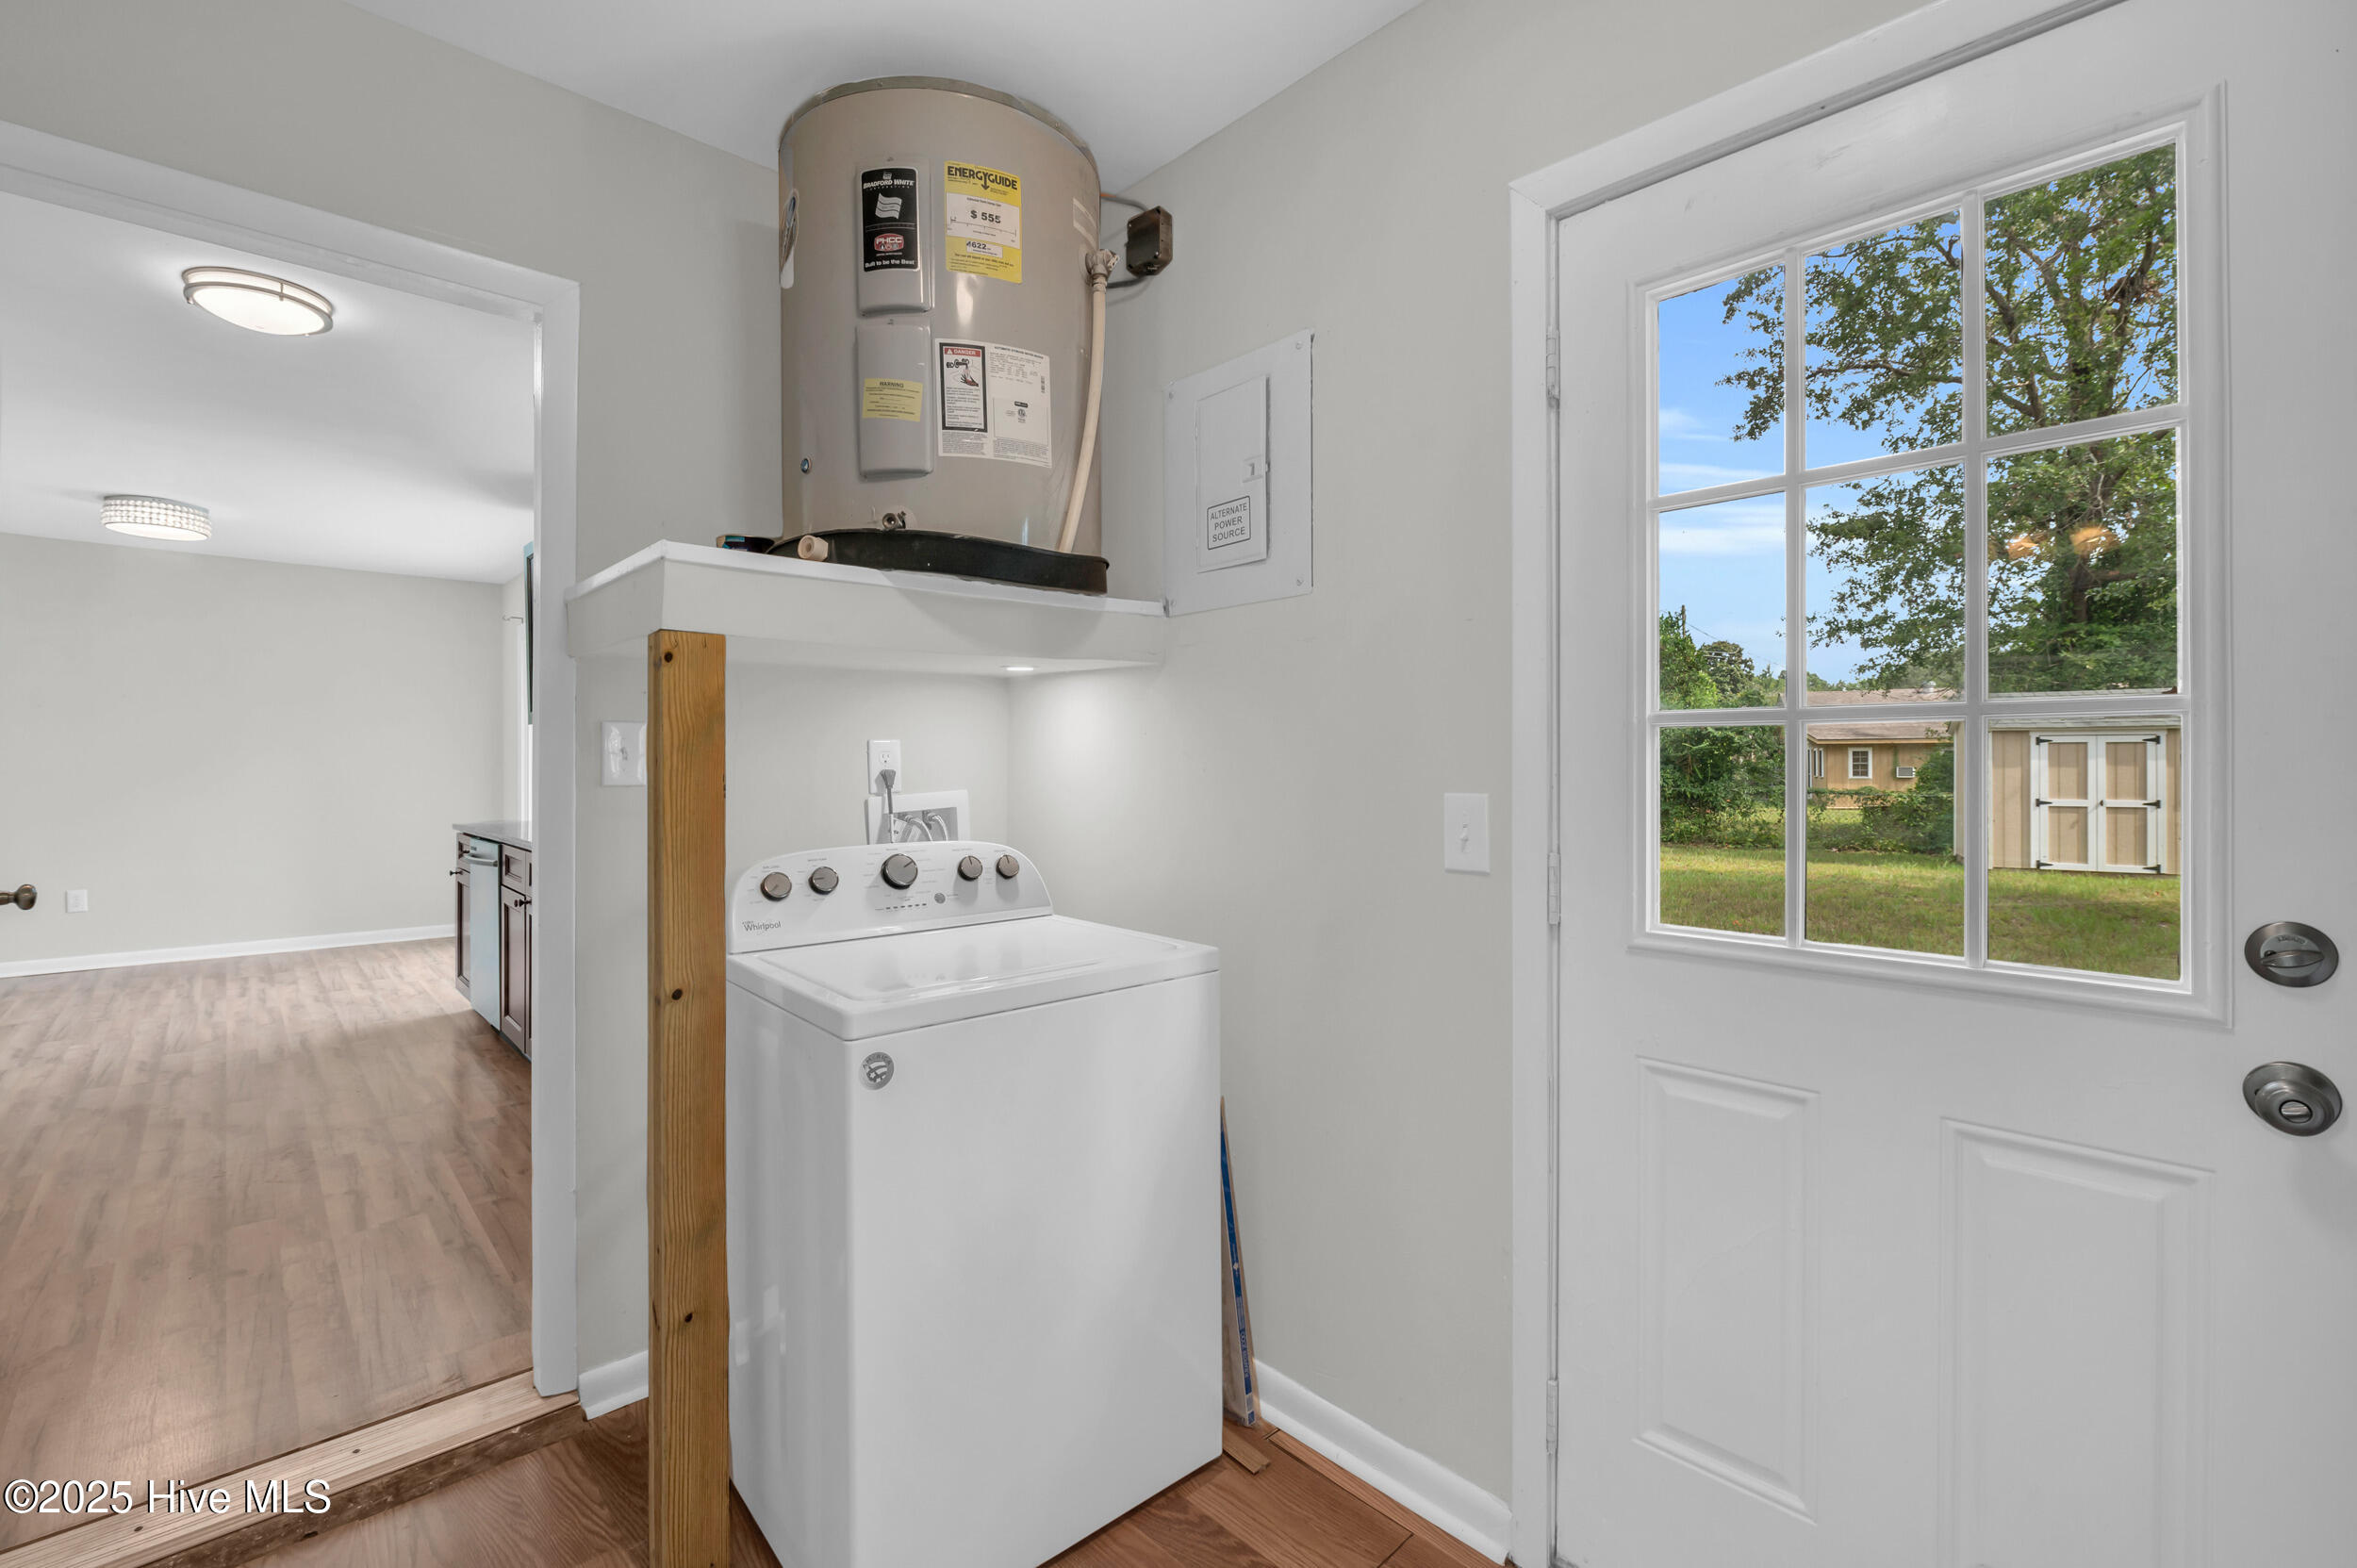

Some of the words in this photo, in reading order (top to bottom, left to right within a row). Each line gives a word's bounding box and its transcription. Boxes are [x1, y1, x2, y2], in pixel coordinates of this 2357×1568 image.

[863, 180, 893, 190] BRADFORD
[894, 178, 915, 187] WHITE
[948, 166, 1018, 190] ENERGYGUIDE
[970, 209, 978, 219] $
[981, 212, 1001, 223] 555
[876, 237, 902, 245] PHCC
[1211, 503, 1247, 520] ALTERNATE
[1214, 516, 1243, 531] POWER
[1212, 526, 1245, 542] SOURCE
[743, 920, 782, 932] Whirlpool
